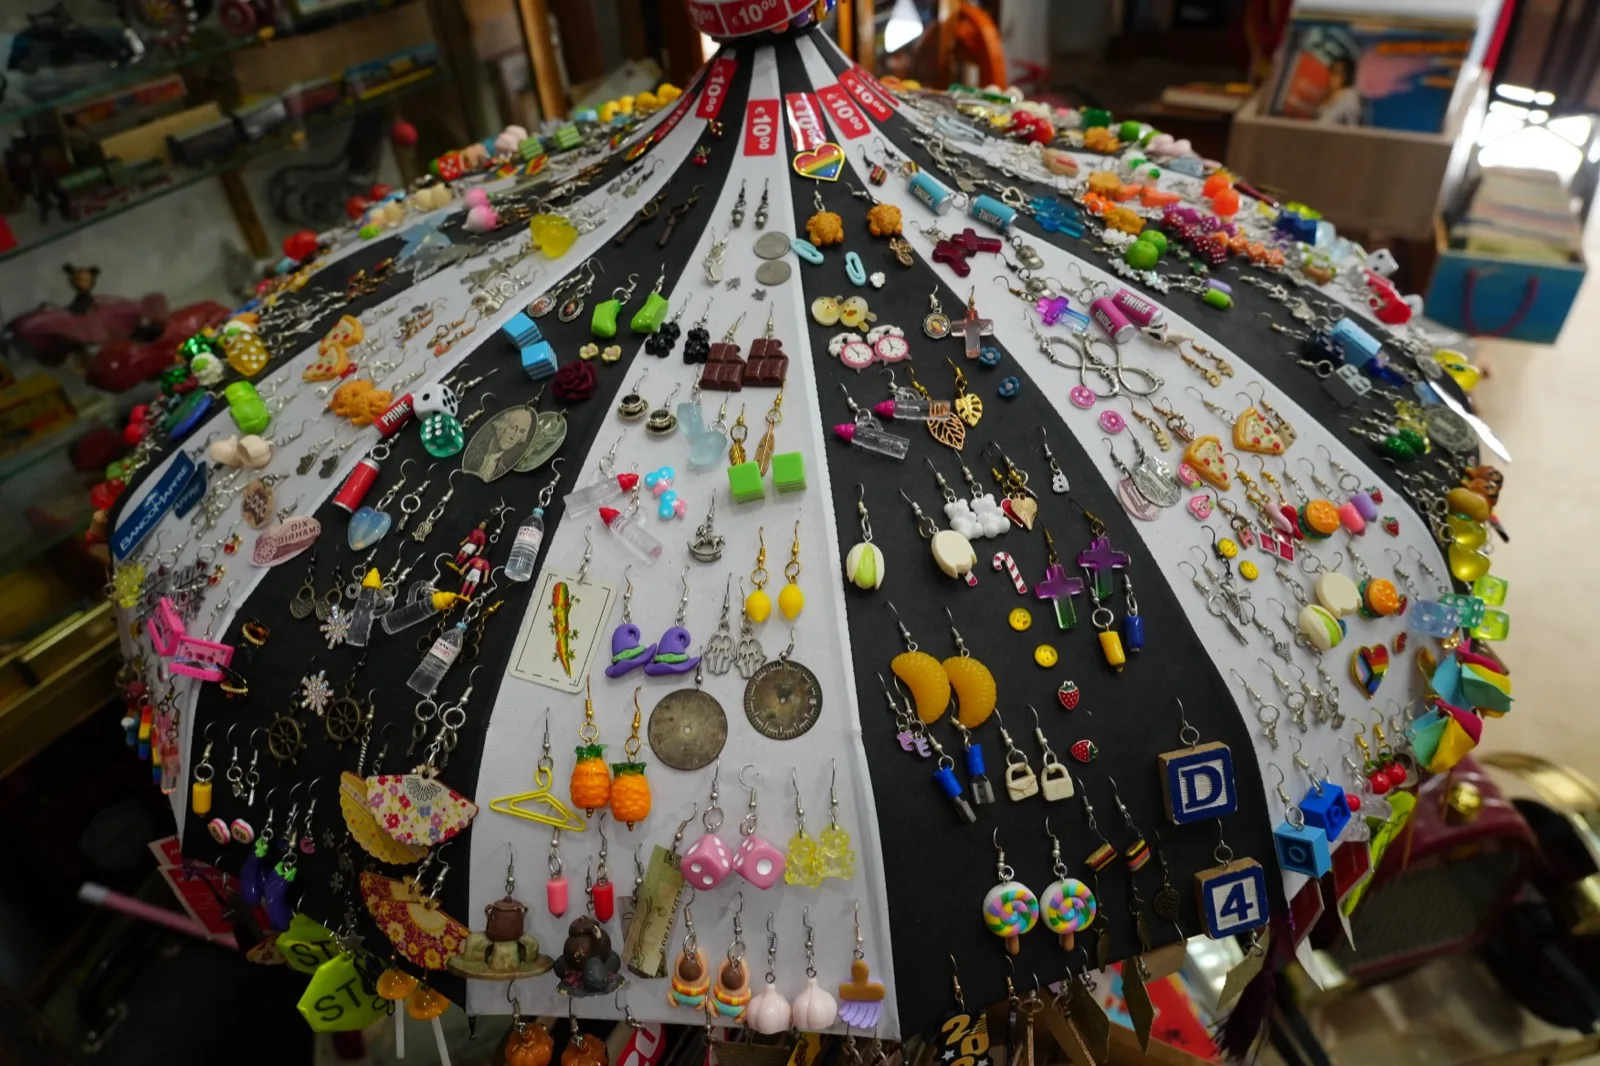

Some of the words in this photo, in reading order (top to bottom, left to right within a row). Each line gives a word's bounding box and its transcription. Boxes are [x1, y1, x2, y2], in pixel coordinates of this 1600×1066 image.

[1121, 293, 1151, 315] PRIME
[381, 400, 411, 427] PRIME
[291, 519, 309, 532] DIX
[1180, 765, 1222, 809] D
[1219, 882, 1254, 921] 4
